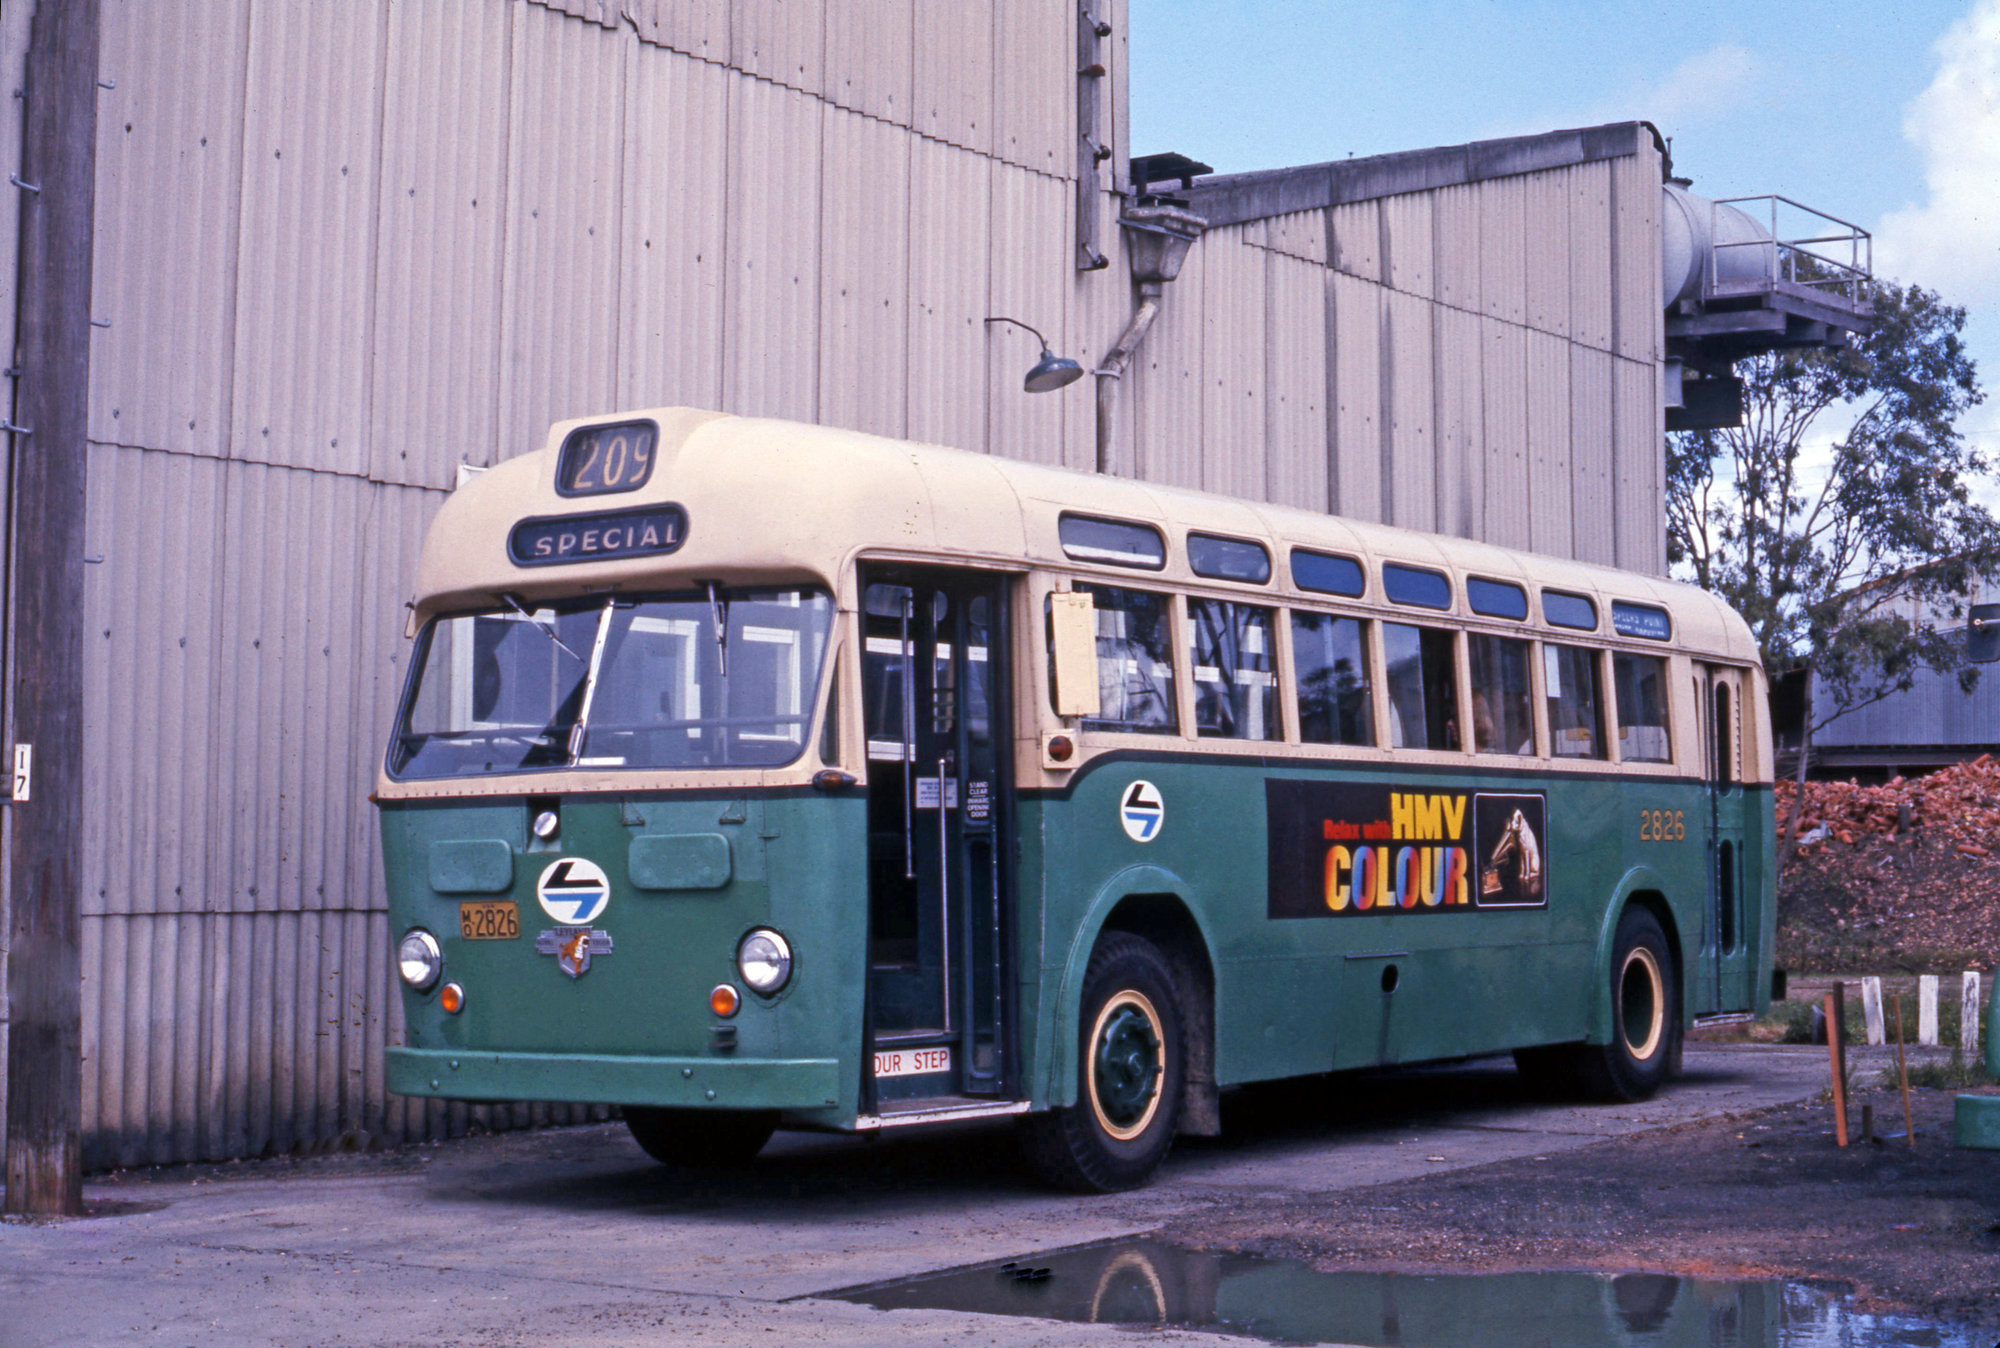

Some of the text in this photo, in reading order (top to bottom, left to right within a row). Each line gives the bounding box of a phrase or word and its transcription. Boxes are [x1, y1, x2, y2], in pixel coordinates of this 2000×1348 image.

[573, 433, 651, 489] 209
[534, 523, 678, 556] SPECIAL
[1323, 792, 1467, 840] Relax with HMV
[1640, 808, 1685, 841] 2826
[1324, 845, 1468, 911] COLOUR
[475, 909, 518, 937] 2826
[914, 1050, 948, 1070] STEP
